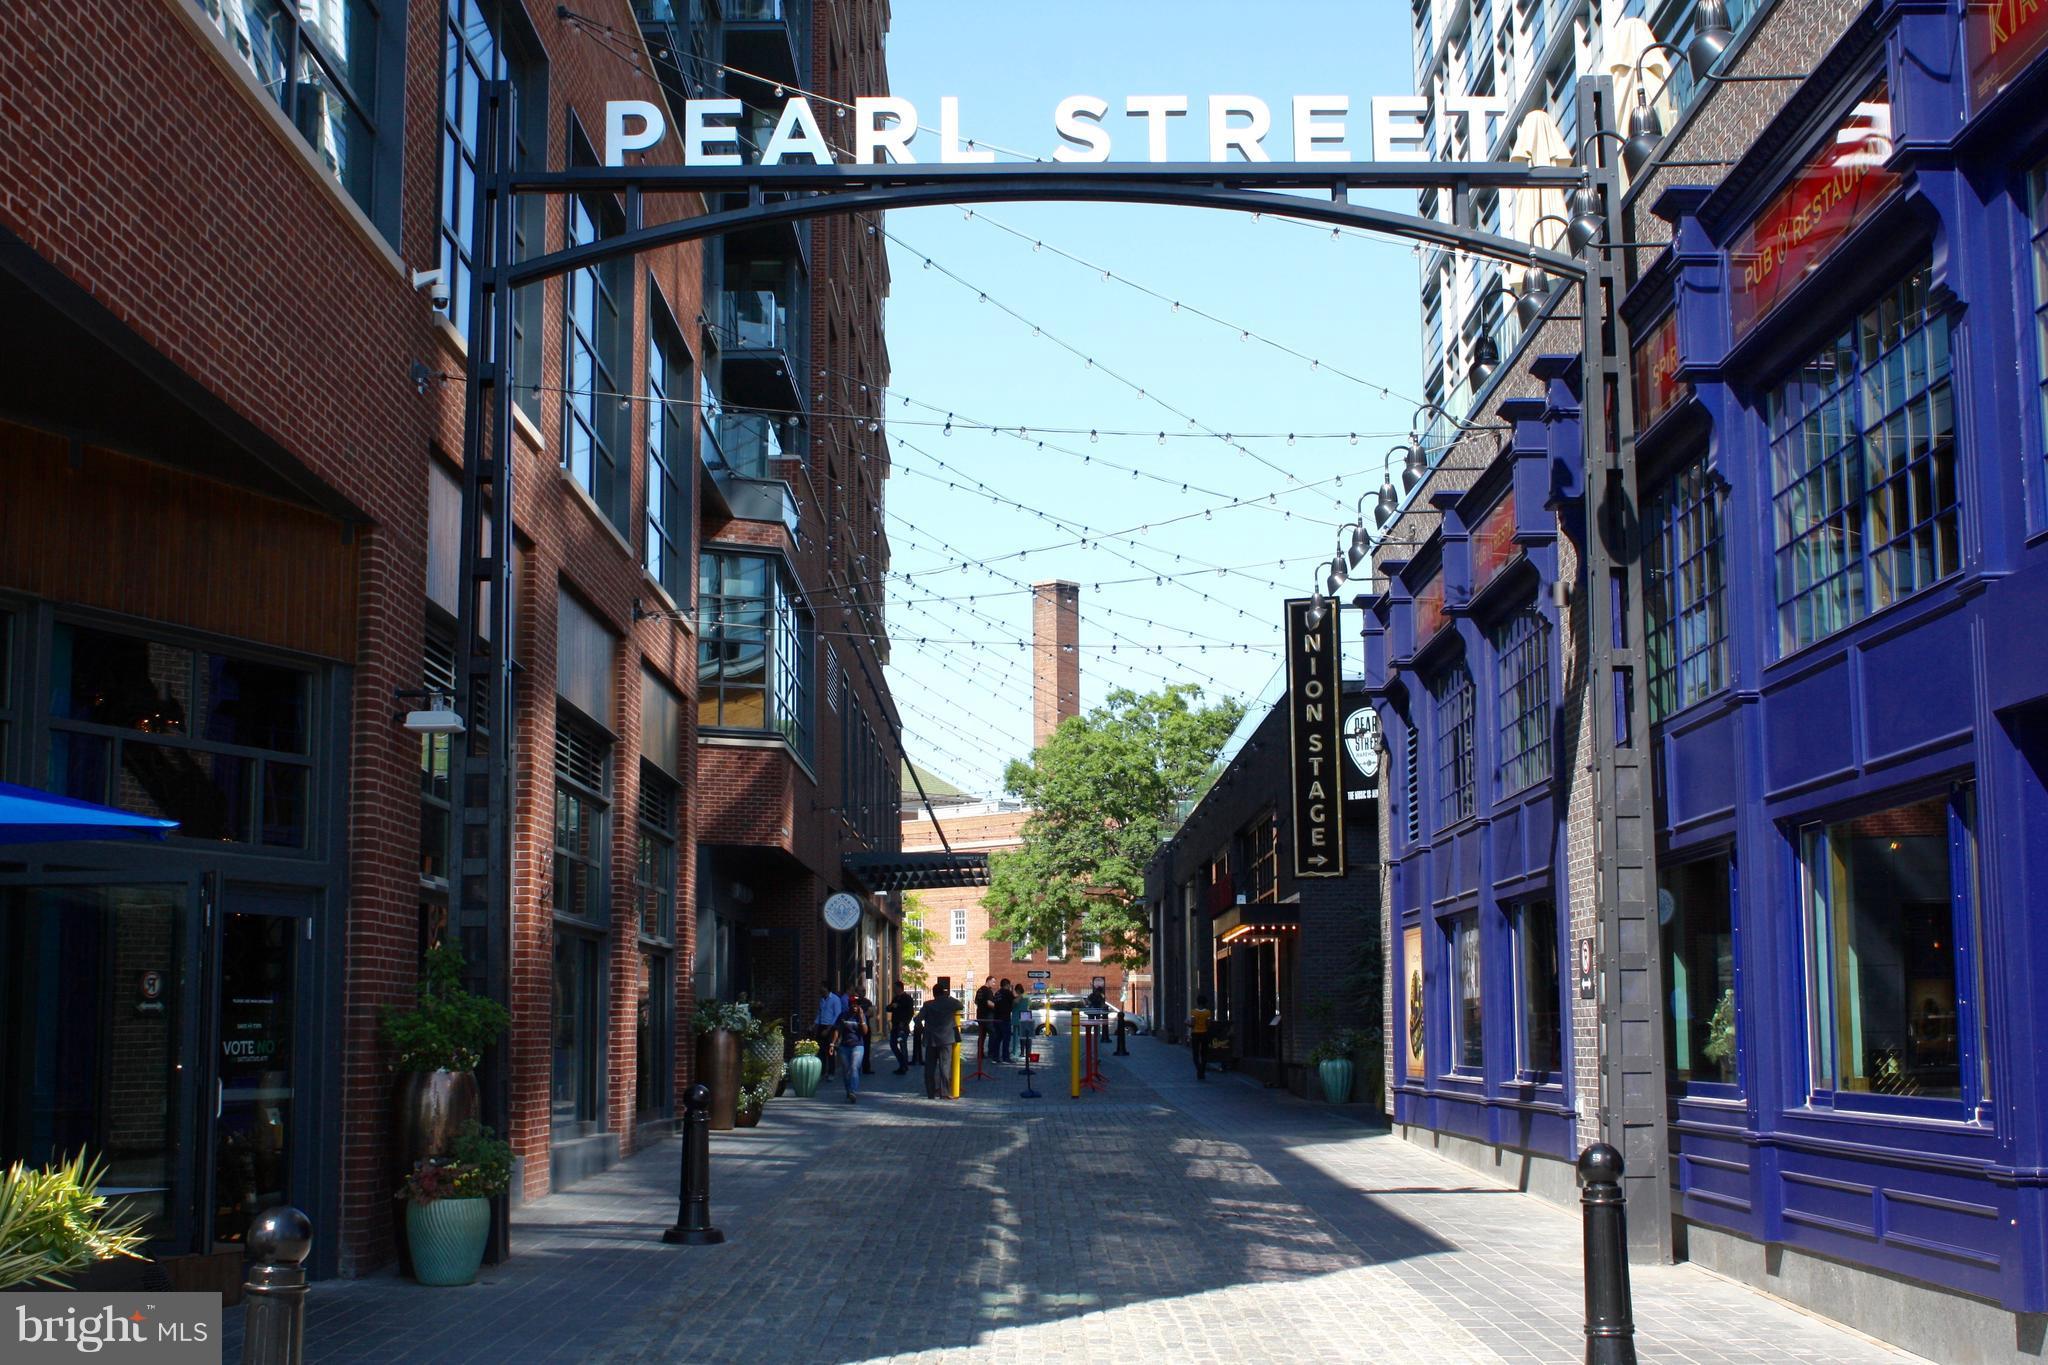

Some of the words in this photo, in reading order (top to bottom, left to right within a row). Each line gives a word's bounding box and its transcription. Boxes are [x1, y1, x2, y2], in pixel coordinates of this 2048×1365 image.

[605, 96, 995, 167] PEARL
[1052, 95, 1509, 163] STREET
[1744, 246, 1773, 294] PUB
[1308, 733, 1326, 847] STAGE
[222, 1040, 255, 1056] VOTE
